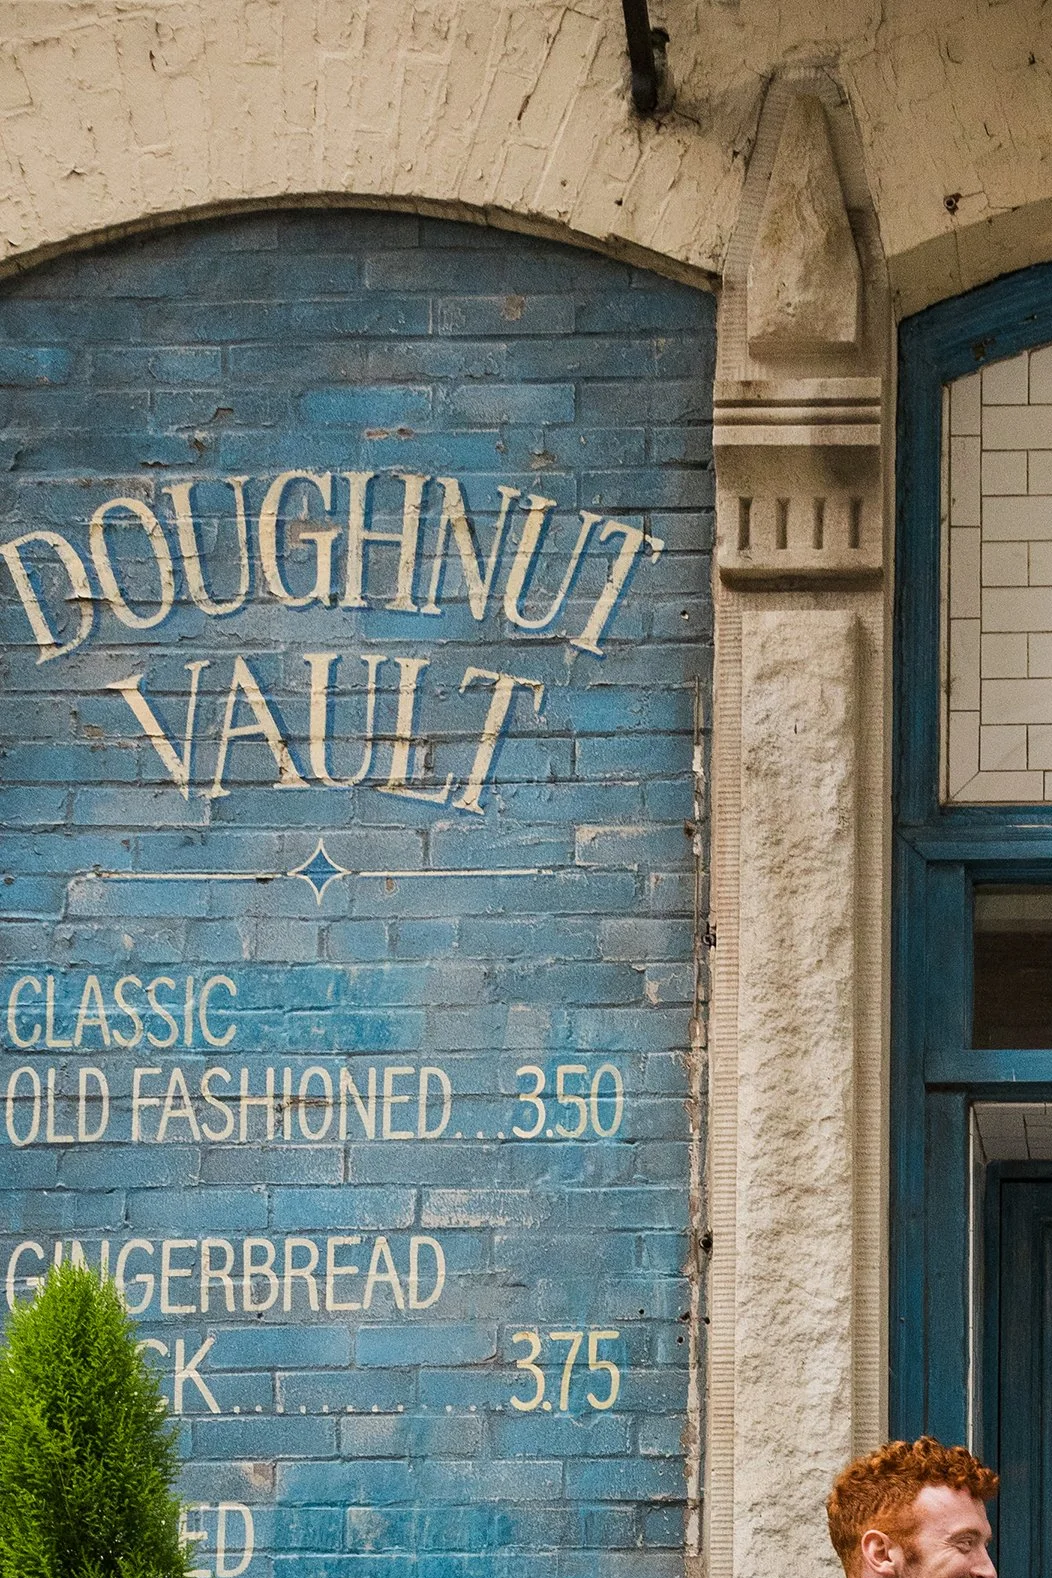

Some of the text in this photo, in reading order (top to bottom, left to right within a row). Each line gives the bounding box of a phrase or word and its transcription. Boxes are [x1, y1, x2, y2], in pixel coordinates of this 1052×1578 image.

[0, 470, 666, 664] DOUGHNUT
[106, 653, 544, 815] VAULT
[7, 974, 237, 1048] CLASSIC
[5, 1066, 109, 1147] OLD
[512, 1063, 625, 1139] 3.50
[510, 1331, 621, 1412] 3.75
